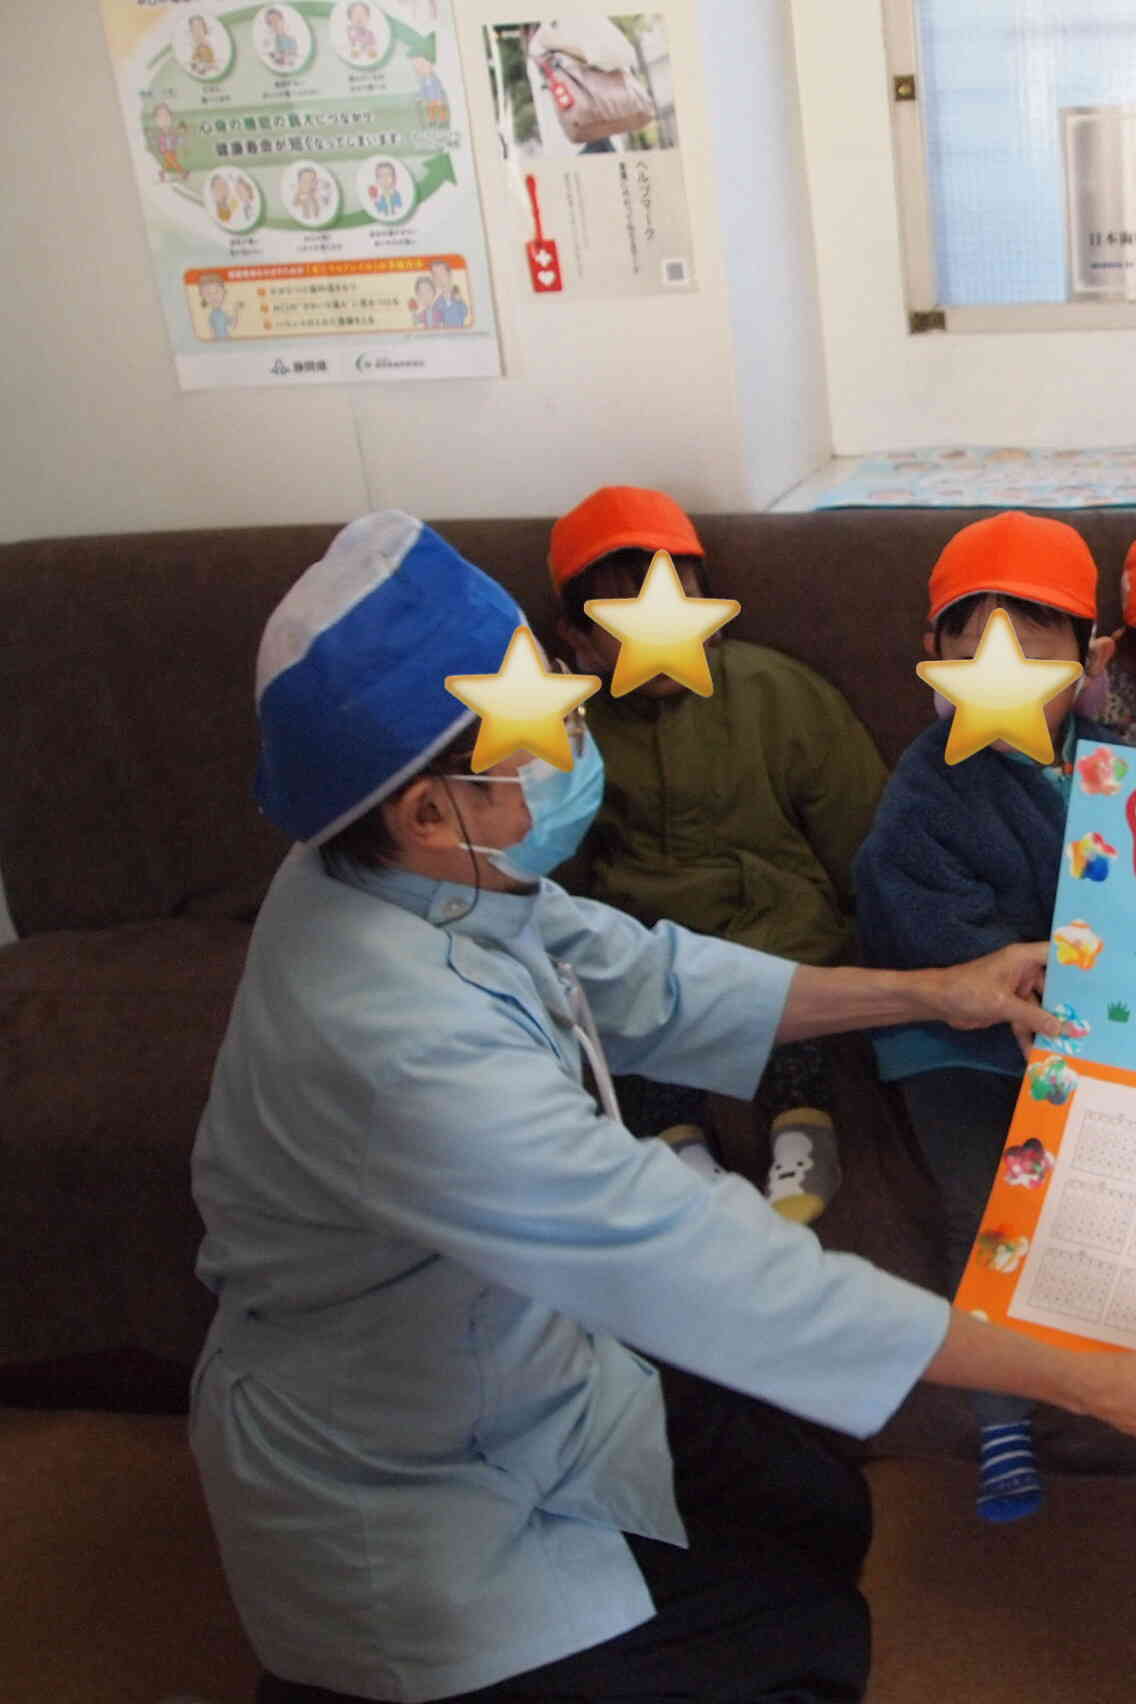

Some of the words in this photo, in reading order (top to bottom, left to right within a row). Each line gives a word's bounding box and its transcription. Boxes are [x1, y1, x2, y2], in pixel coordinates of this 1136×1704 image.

[636, 160, 656, 241] ヘルプマーク
